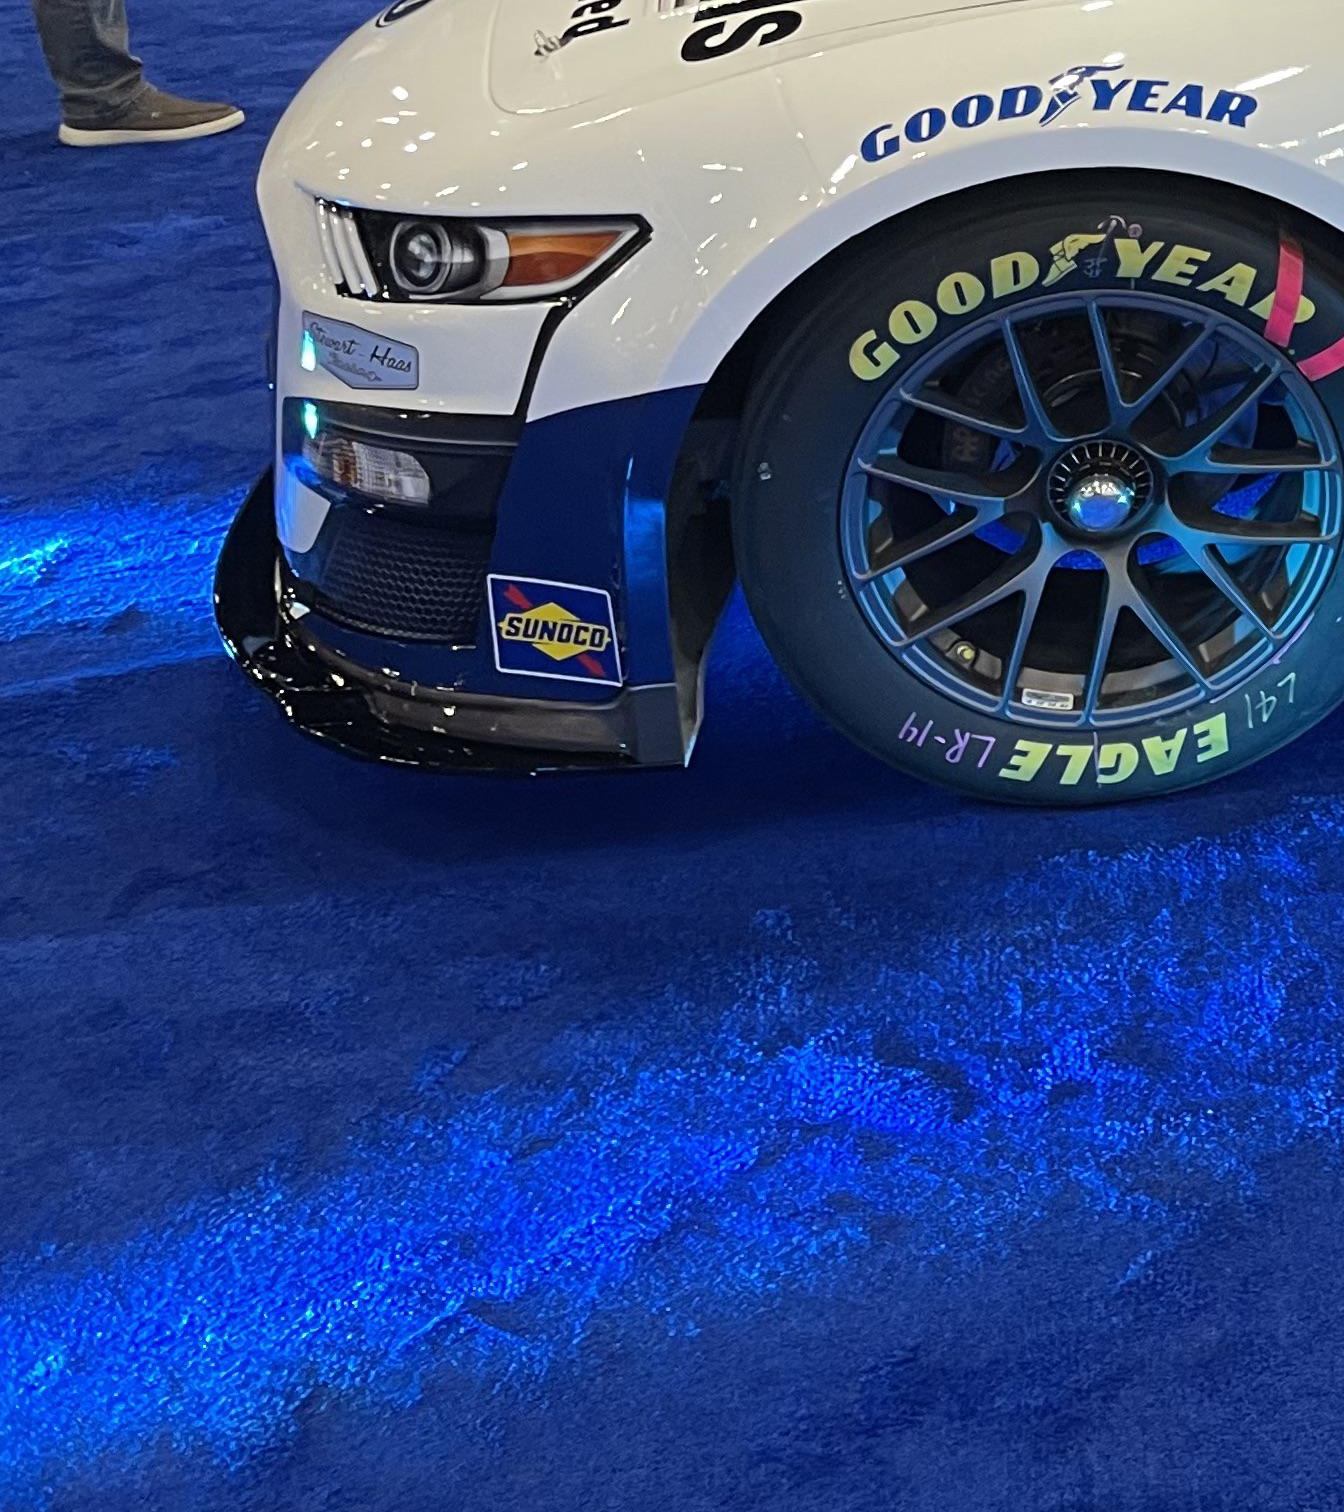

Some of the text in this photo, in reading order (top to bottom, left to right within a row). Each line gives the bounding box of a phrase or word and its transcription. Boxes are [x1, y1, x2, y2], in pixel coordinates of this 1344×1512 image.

[860, 79, 1259, 163] GOODYEAR
[369, 345, 412, 373] Haas
[503, 616, 608, 652] SUNOCO
[999, 711, 1231, 786] EAGLE
